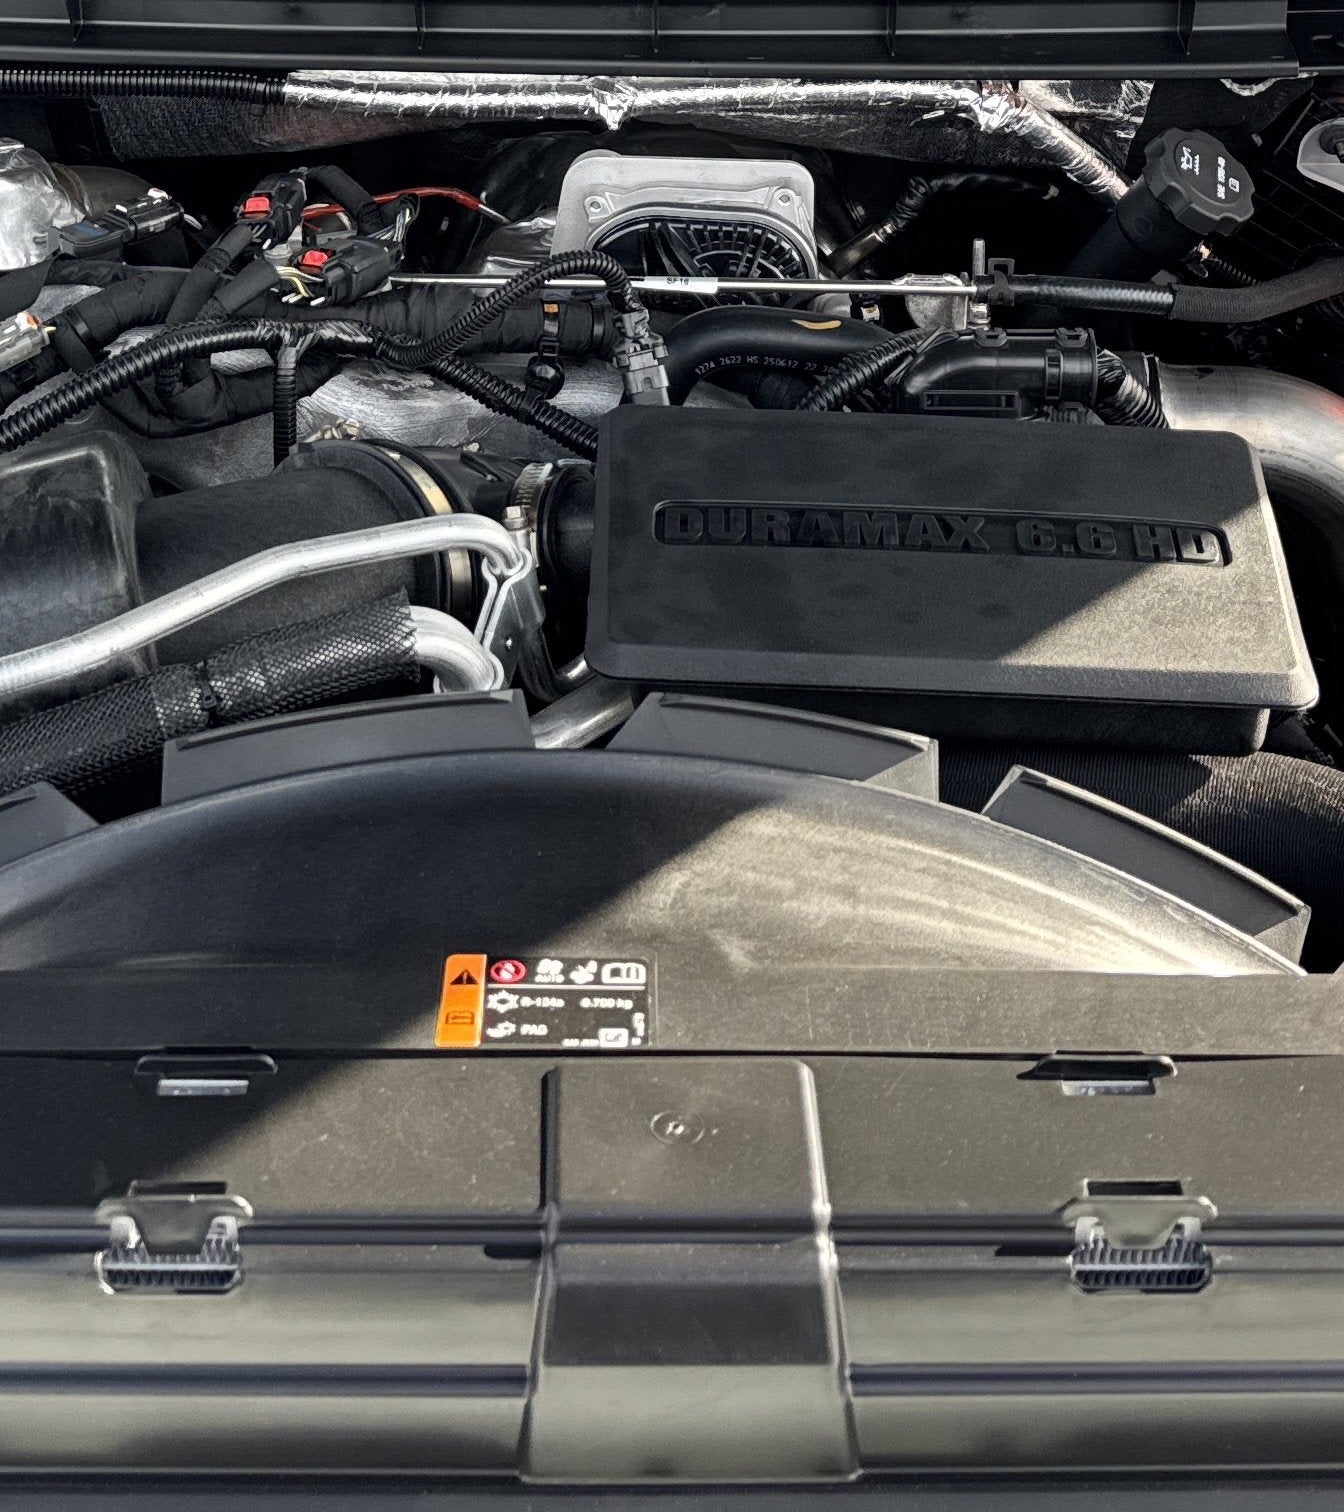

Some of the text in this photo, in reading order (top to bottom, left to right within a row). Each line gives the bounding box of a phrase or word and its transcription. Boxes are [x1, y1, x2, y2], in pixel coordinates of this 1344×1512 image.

[664, 507, 1223, 565] DURAMAX 6.6 HD
